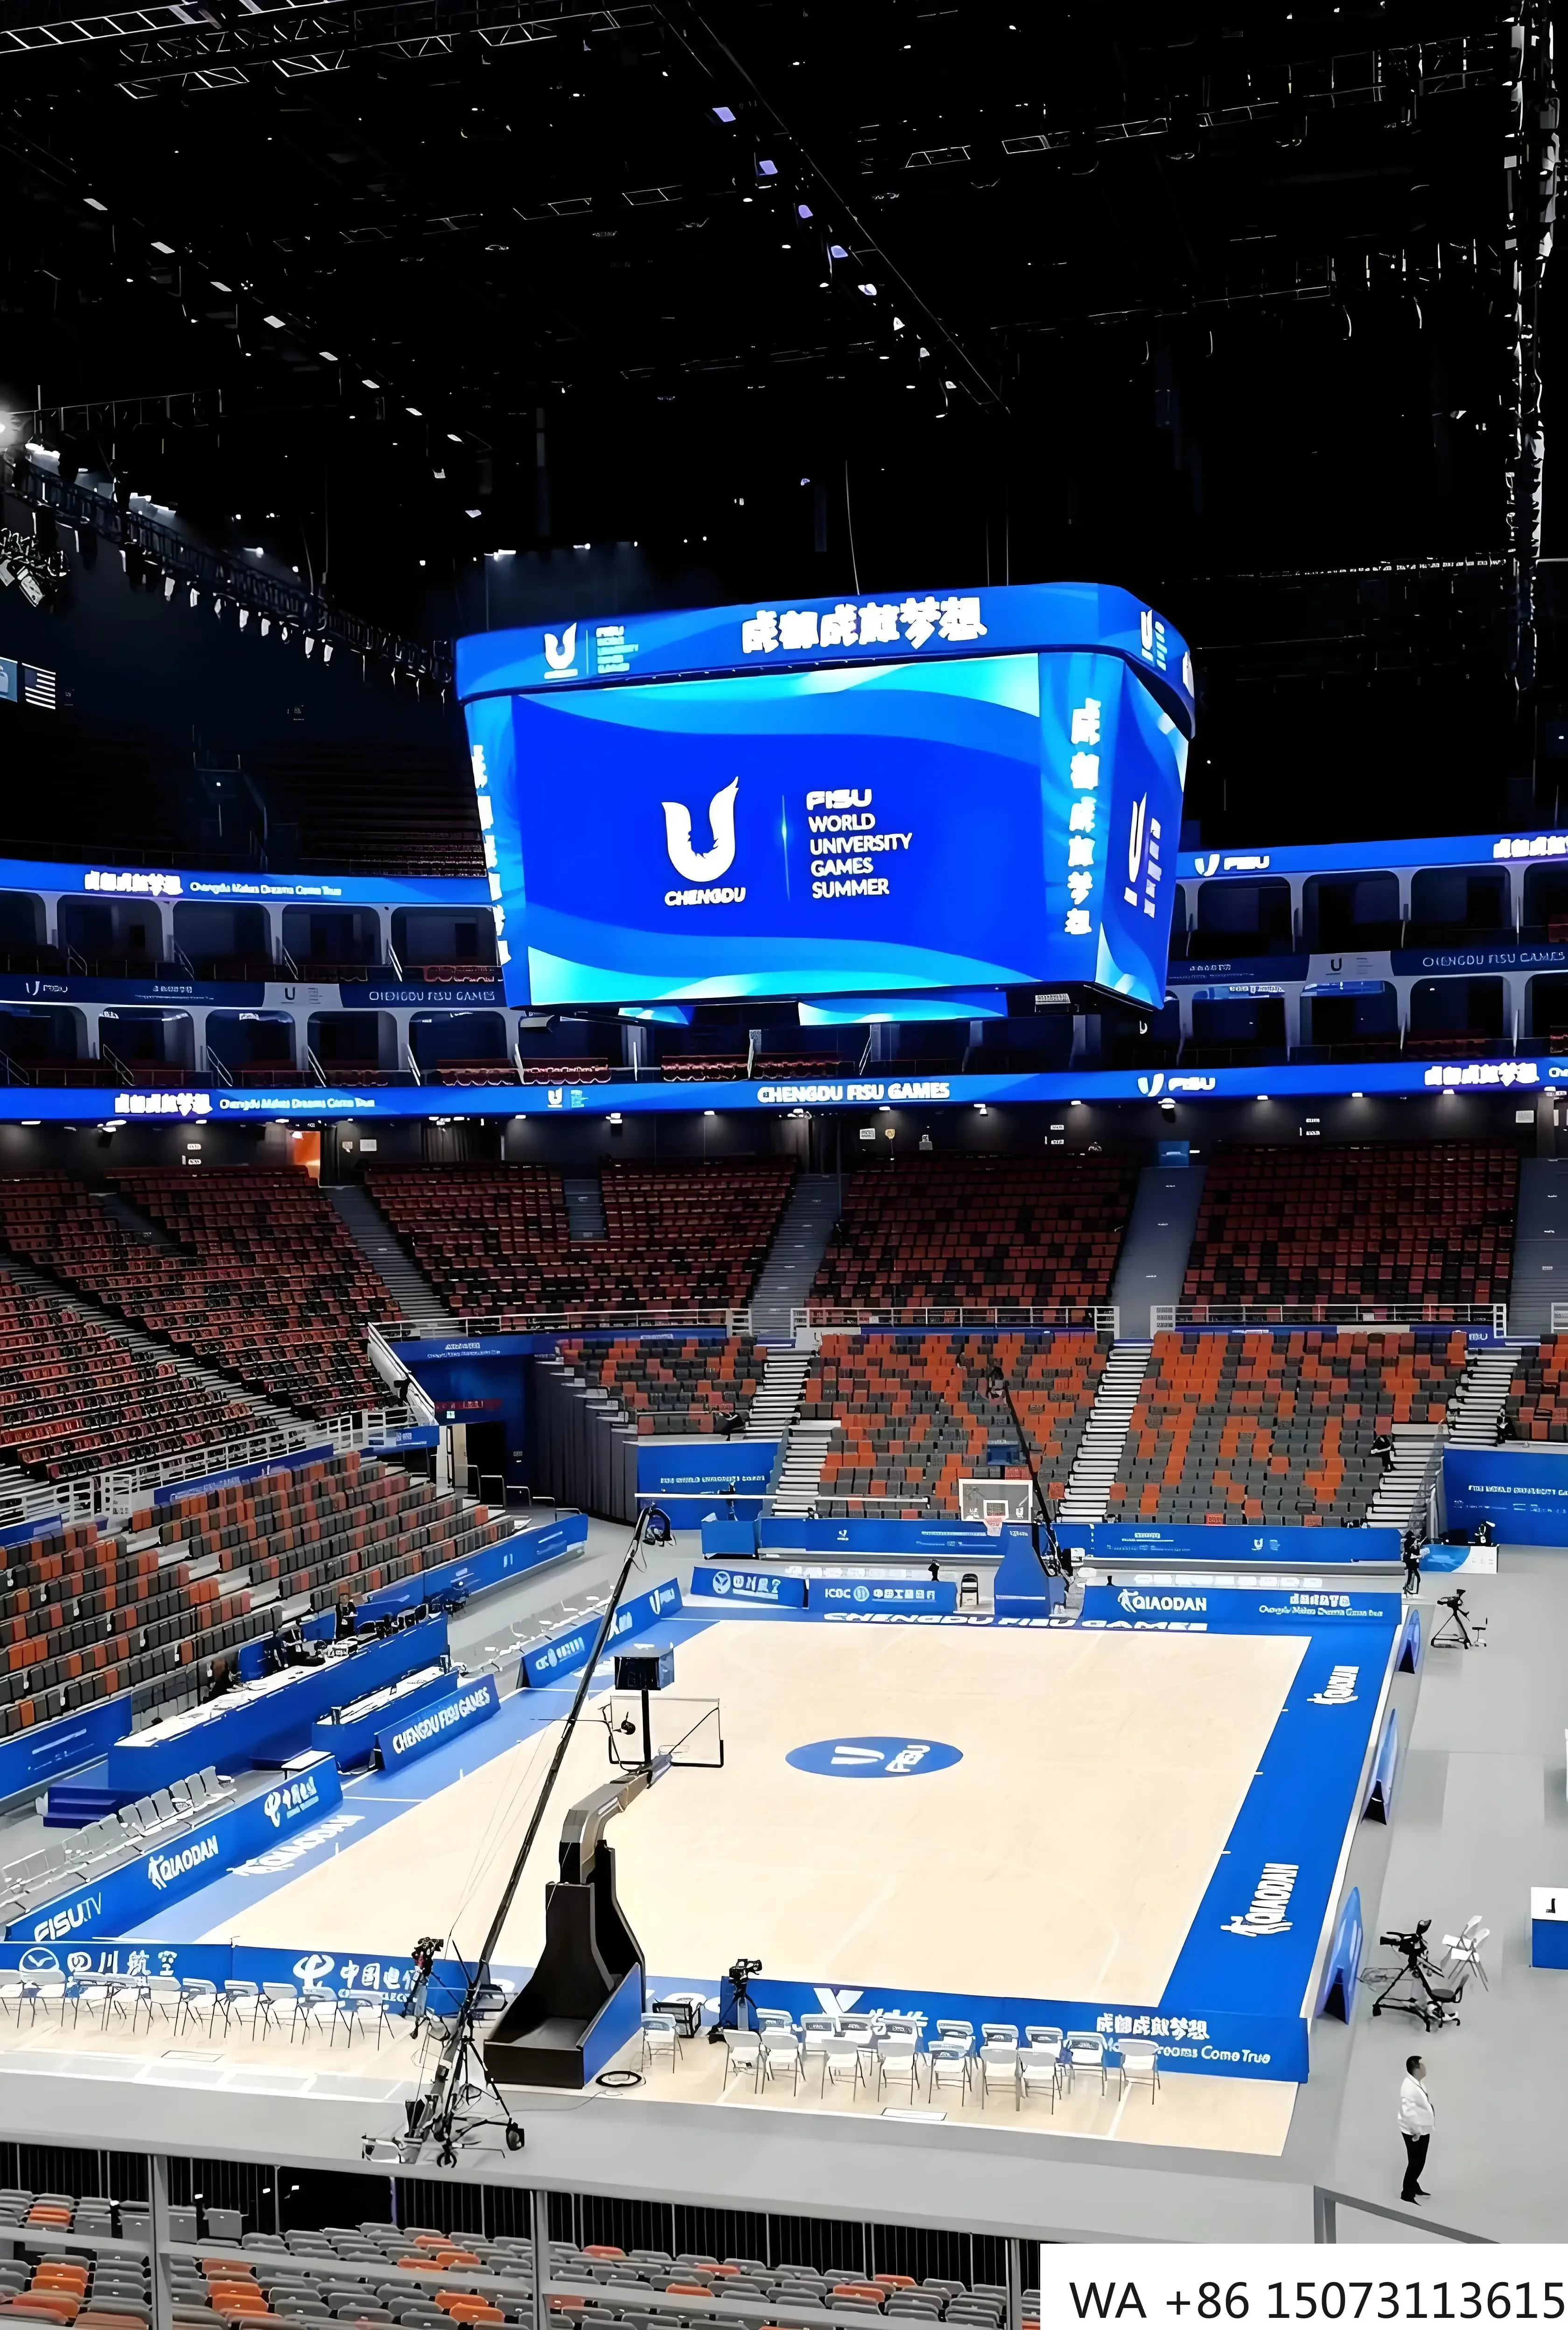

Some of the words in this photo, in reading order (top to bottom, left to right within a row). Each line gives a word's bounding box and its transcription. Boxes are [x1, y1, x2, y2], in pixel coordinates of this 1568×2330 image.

[806, 789, 872, 810] FISU
[808, 813, 875, 833] WORLD
[810, 833, 913, 855] UNIVERSITY
[811, 857, 874, 877] GAMES
[665, 887, 746, 906] CHENGDU
[812, 878, 889, 899] SUMMER
[757, 1085, 843, 1103] CHENGDU
[888, 1082, 950, 1100] GAMES
[1133, 1597, 1207, 1612] QIAODAN
